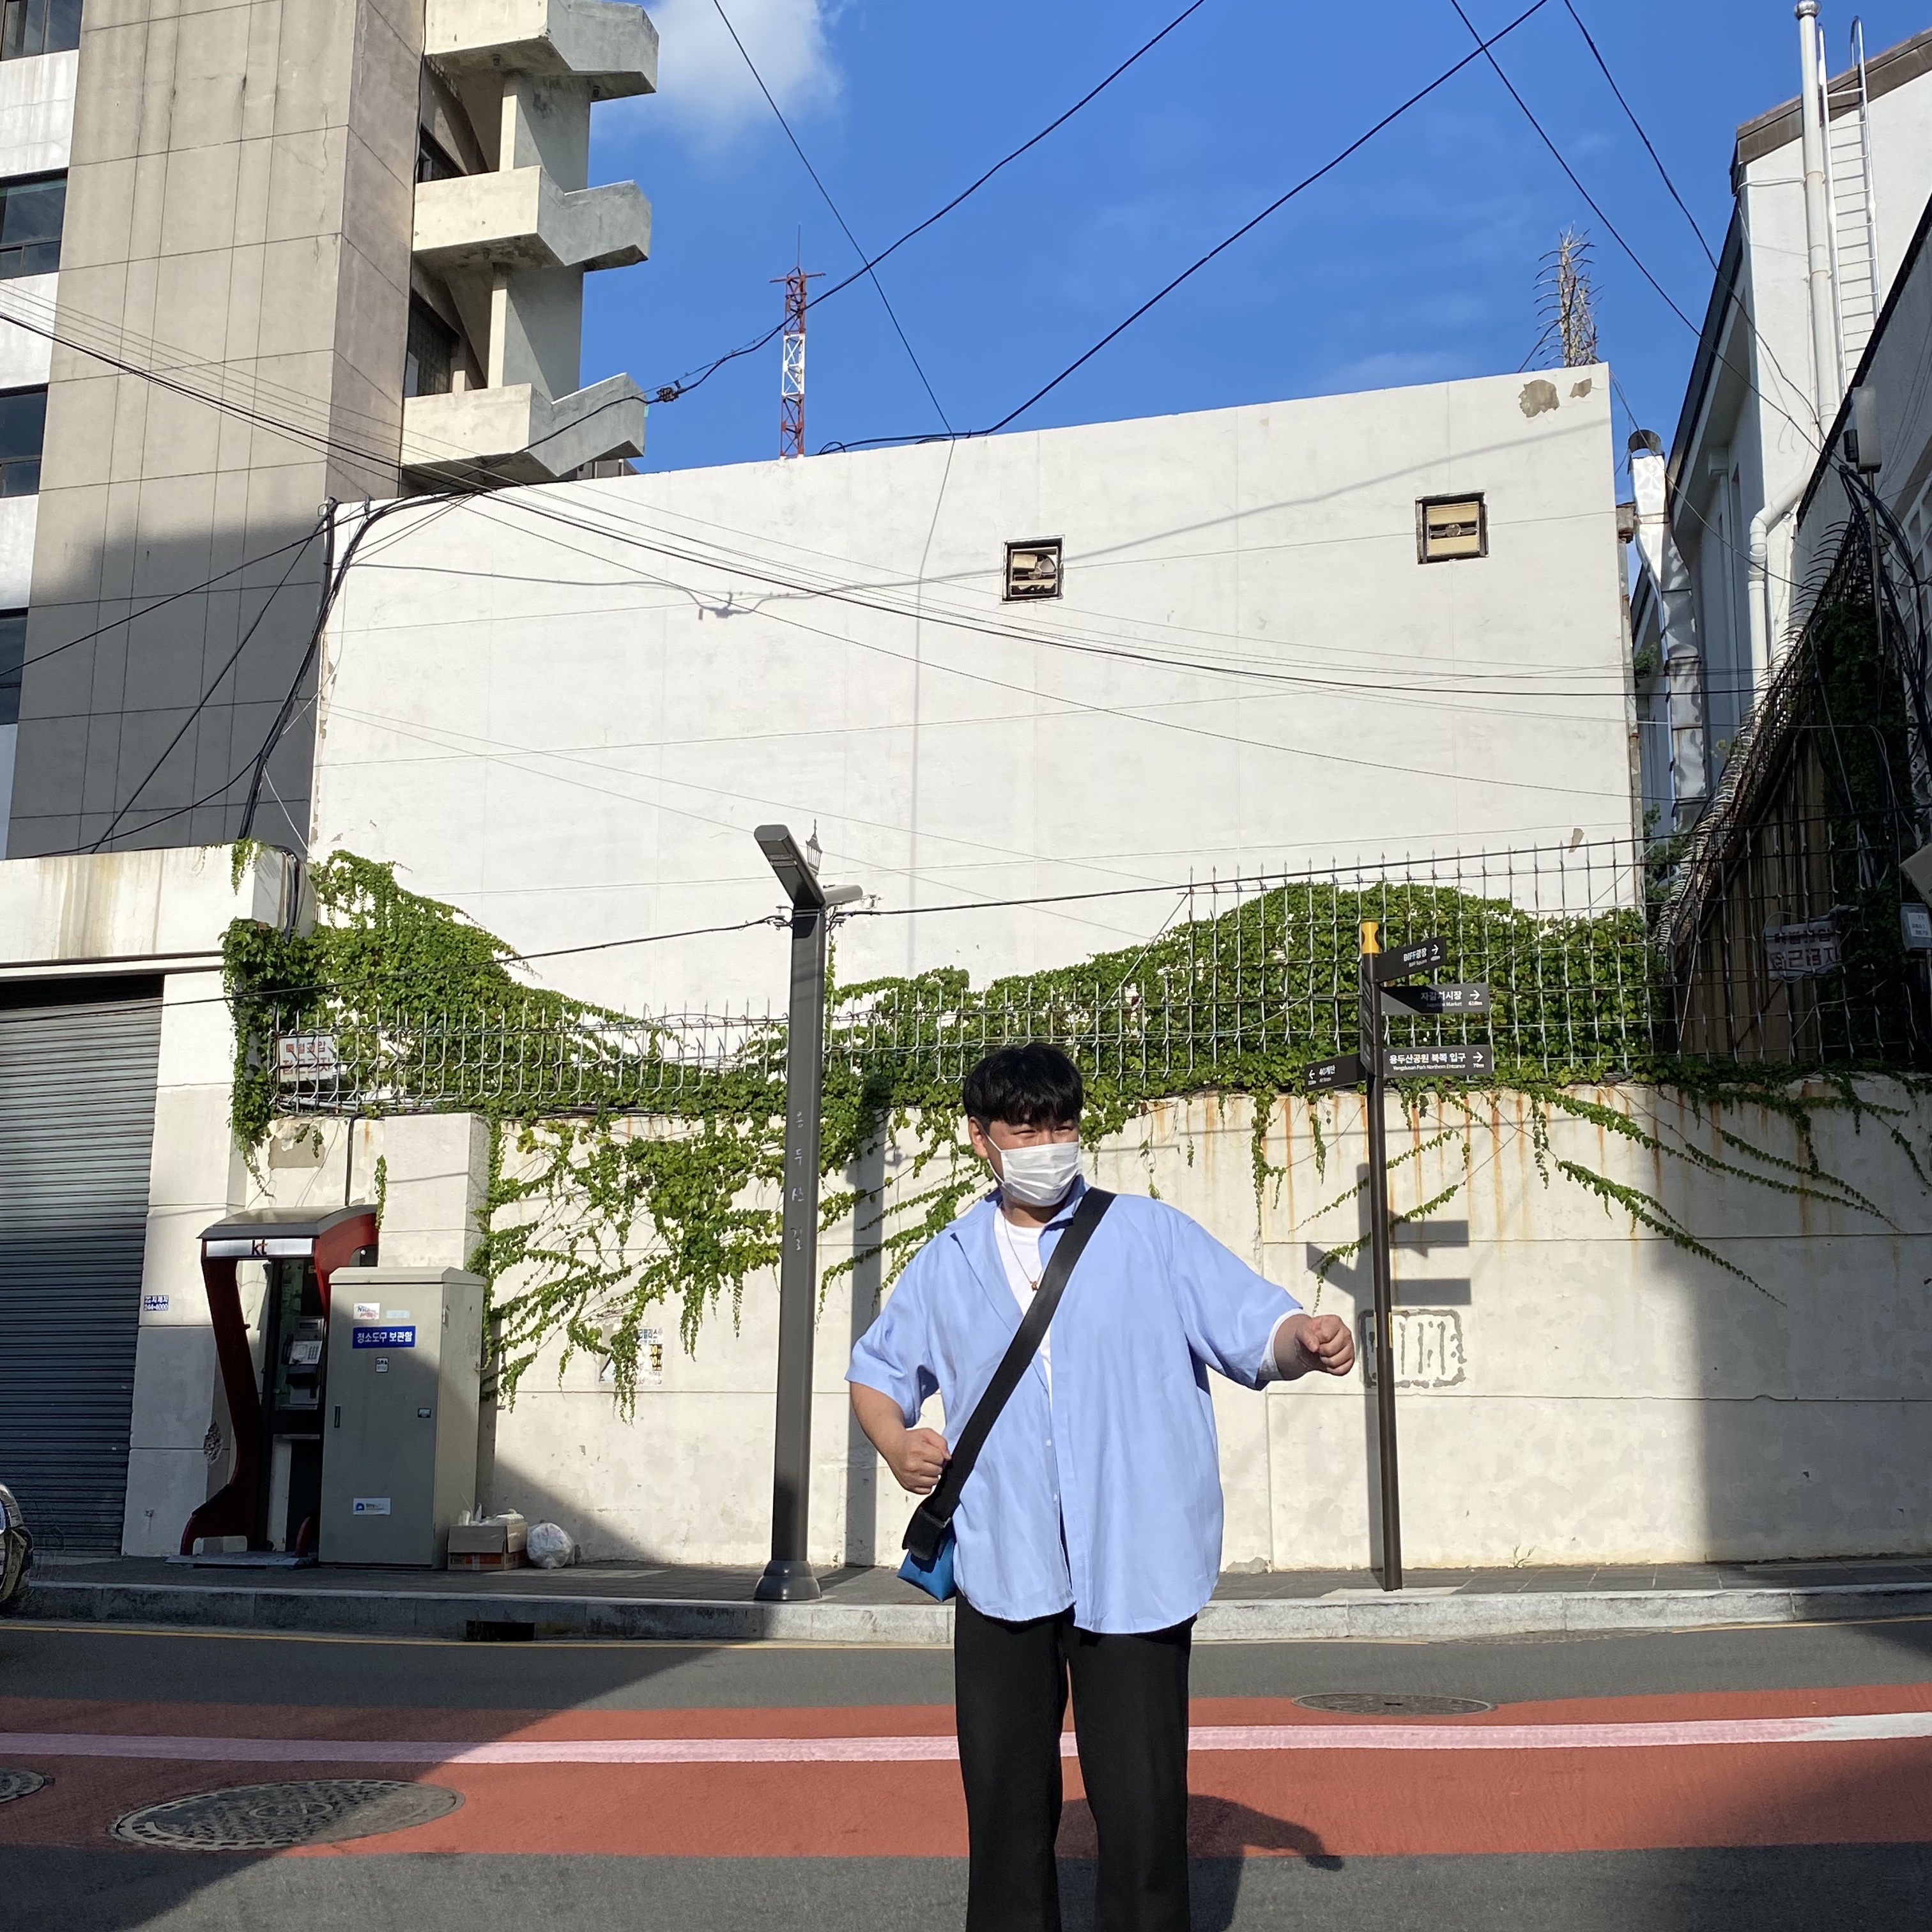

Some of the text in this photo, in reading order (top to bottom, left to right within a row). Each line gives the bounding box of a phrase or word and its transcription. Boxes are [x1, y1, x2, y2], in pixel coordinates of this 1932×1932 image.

[1421, 990, 1462, 1000] 자갈치시장
[1389, 1052, 1466, 1064] 용두산공원 북쪽 입구
[252, 1238, 268, 1255] kt
[356, 1331, 413, 1344] 청소도구 보관함
